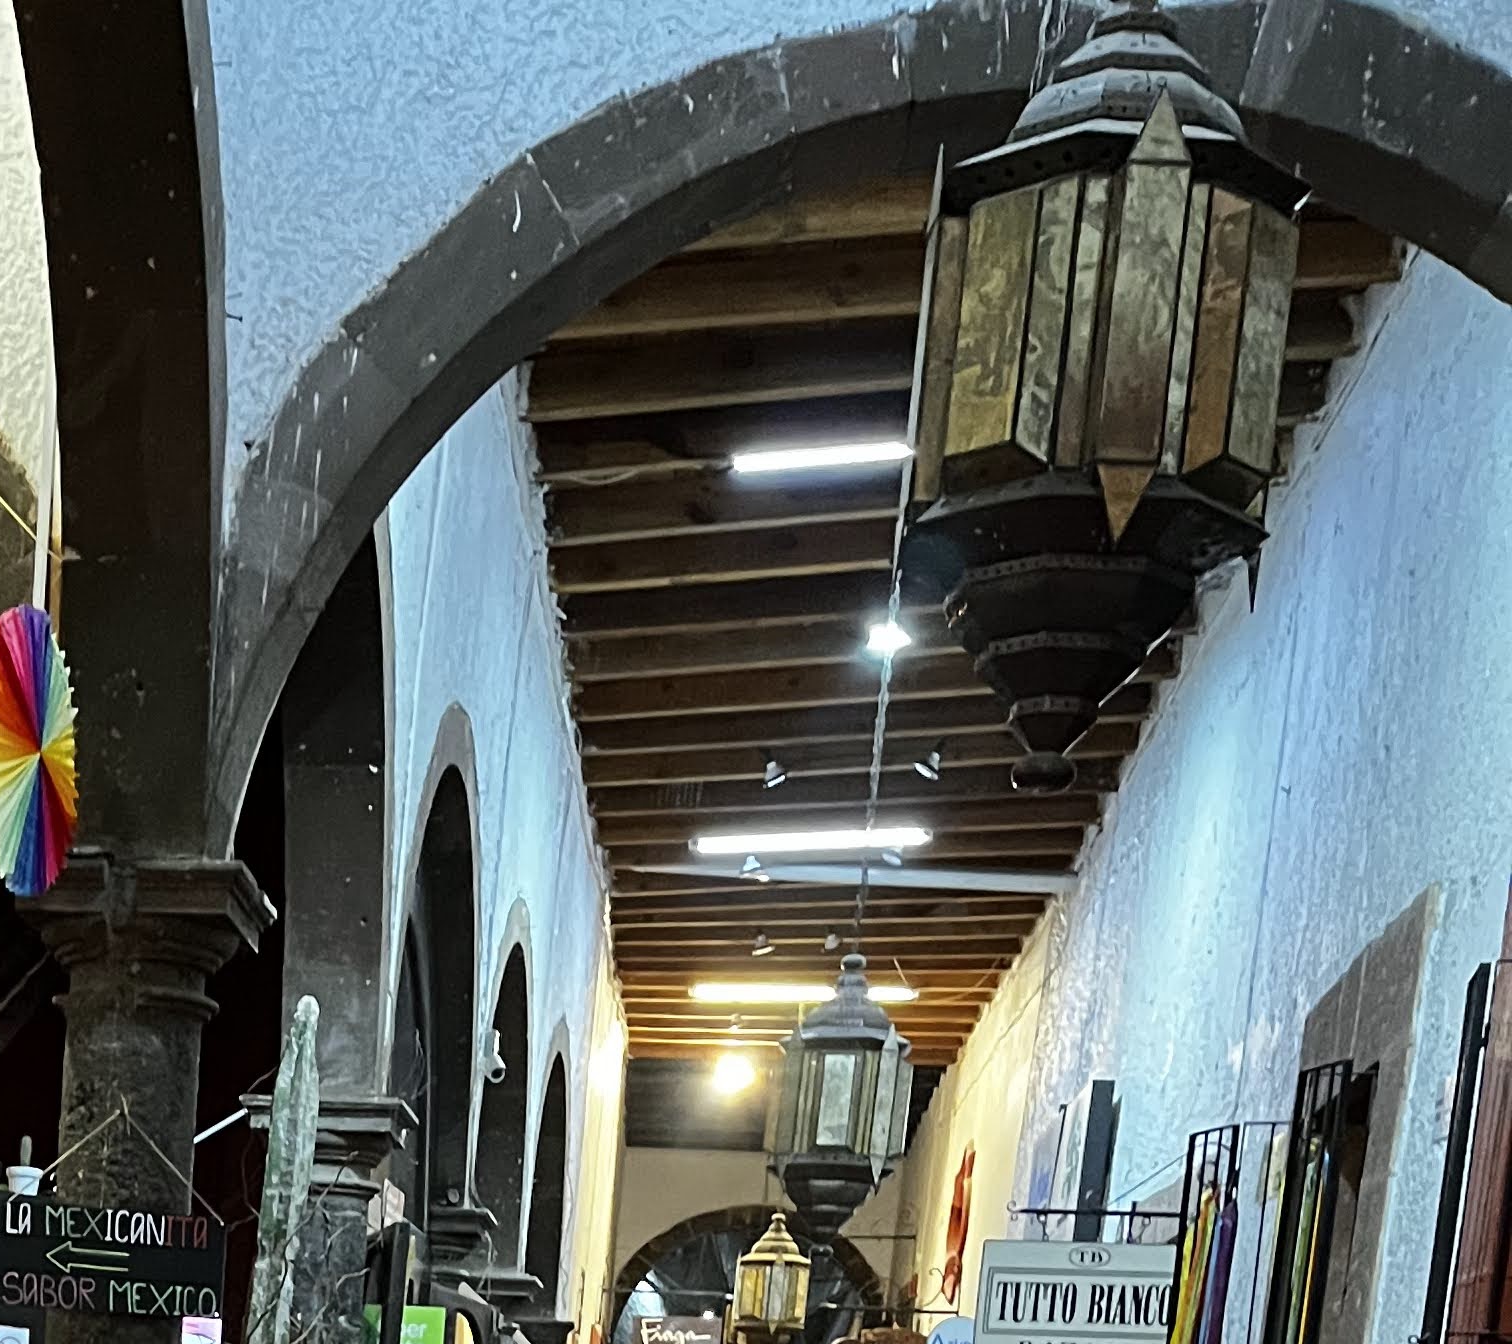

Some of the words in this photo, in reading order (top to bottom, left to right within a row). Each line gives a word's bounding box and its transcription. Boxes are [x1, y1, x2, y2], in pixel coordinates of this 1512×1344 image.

[5, 1202, 32, 1236] LA
[1, 1271, 96, 1311] SABOR
[108, 1279, 217, 1318] MEXICO
[996, 1281, 1078, 1325] TUTTO
[1087, 1283, 1173, 1327] BIANCO
